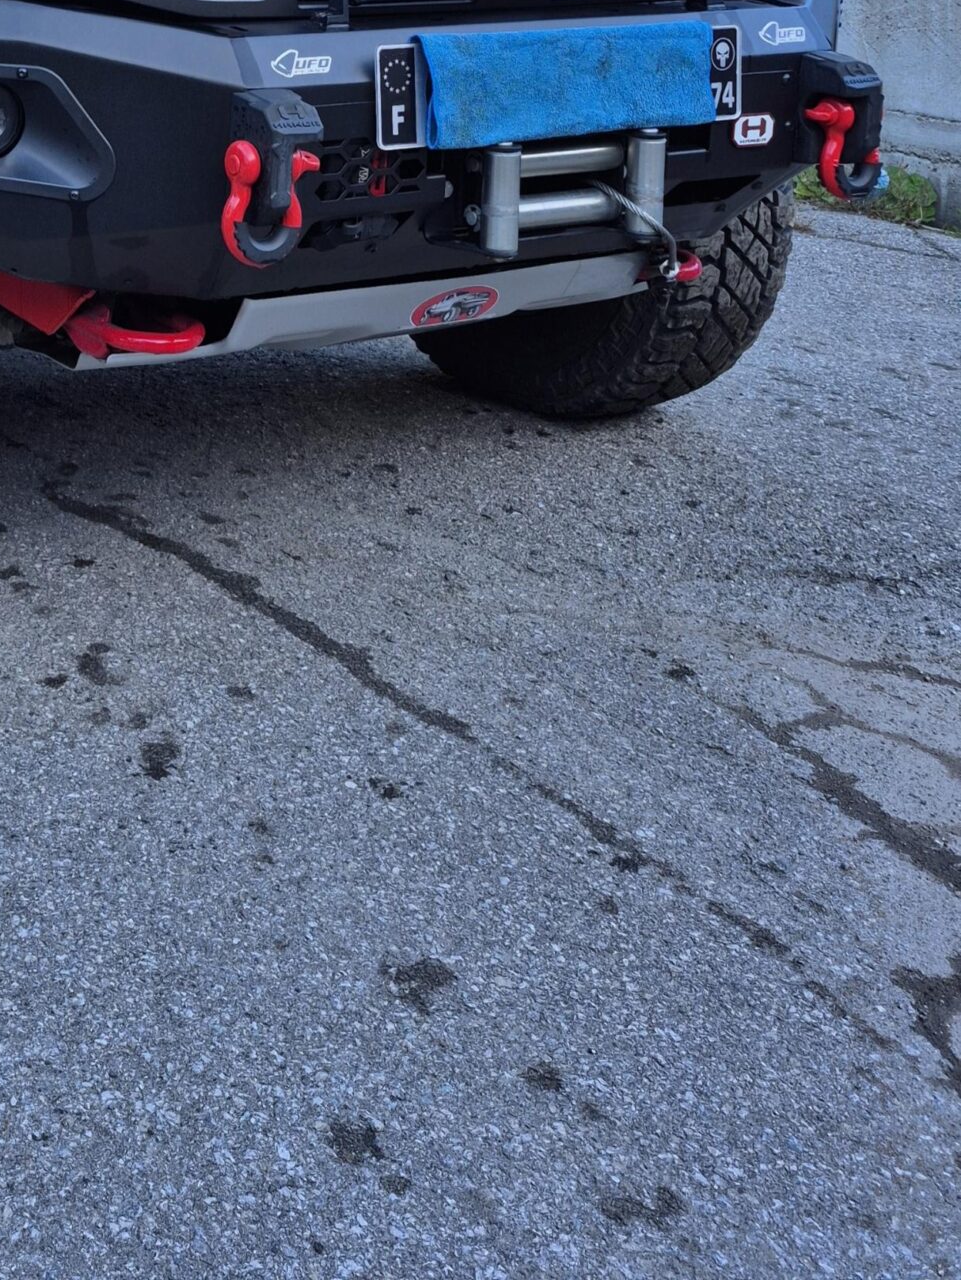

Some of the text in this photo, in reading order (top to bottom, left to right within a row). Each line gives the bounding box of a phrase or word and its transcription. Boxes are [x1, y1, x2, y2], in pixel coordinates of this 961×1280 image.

[779, 29, 803, 38] UFO
[295, 58, 330, 69] UFO
[711, 81, 735, 109] 74
[392, 104, 405, 135] F
